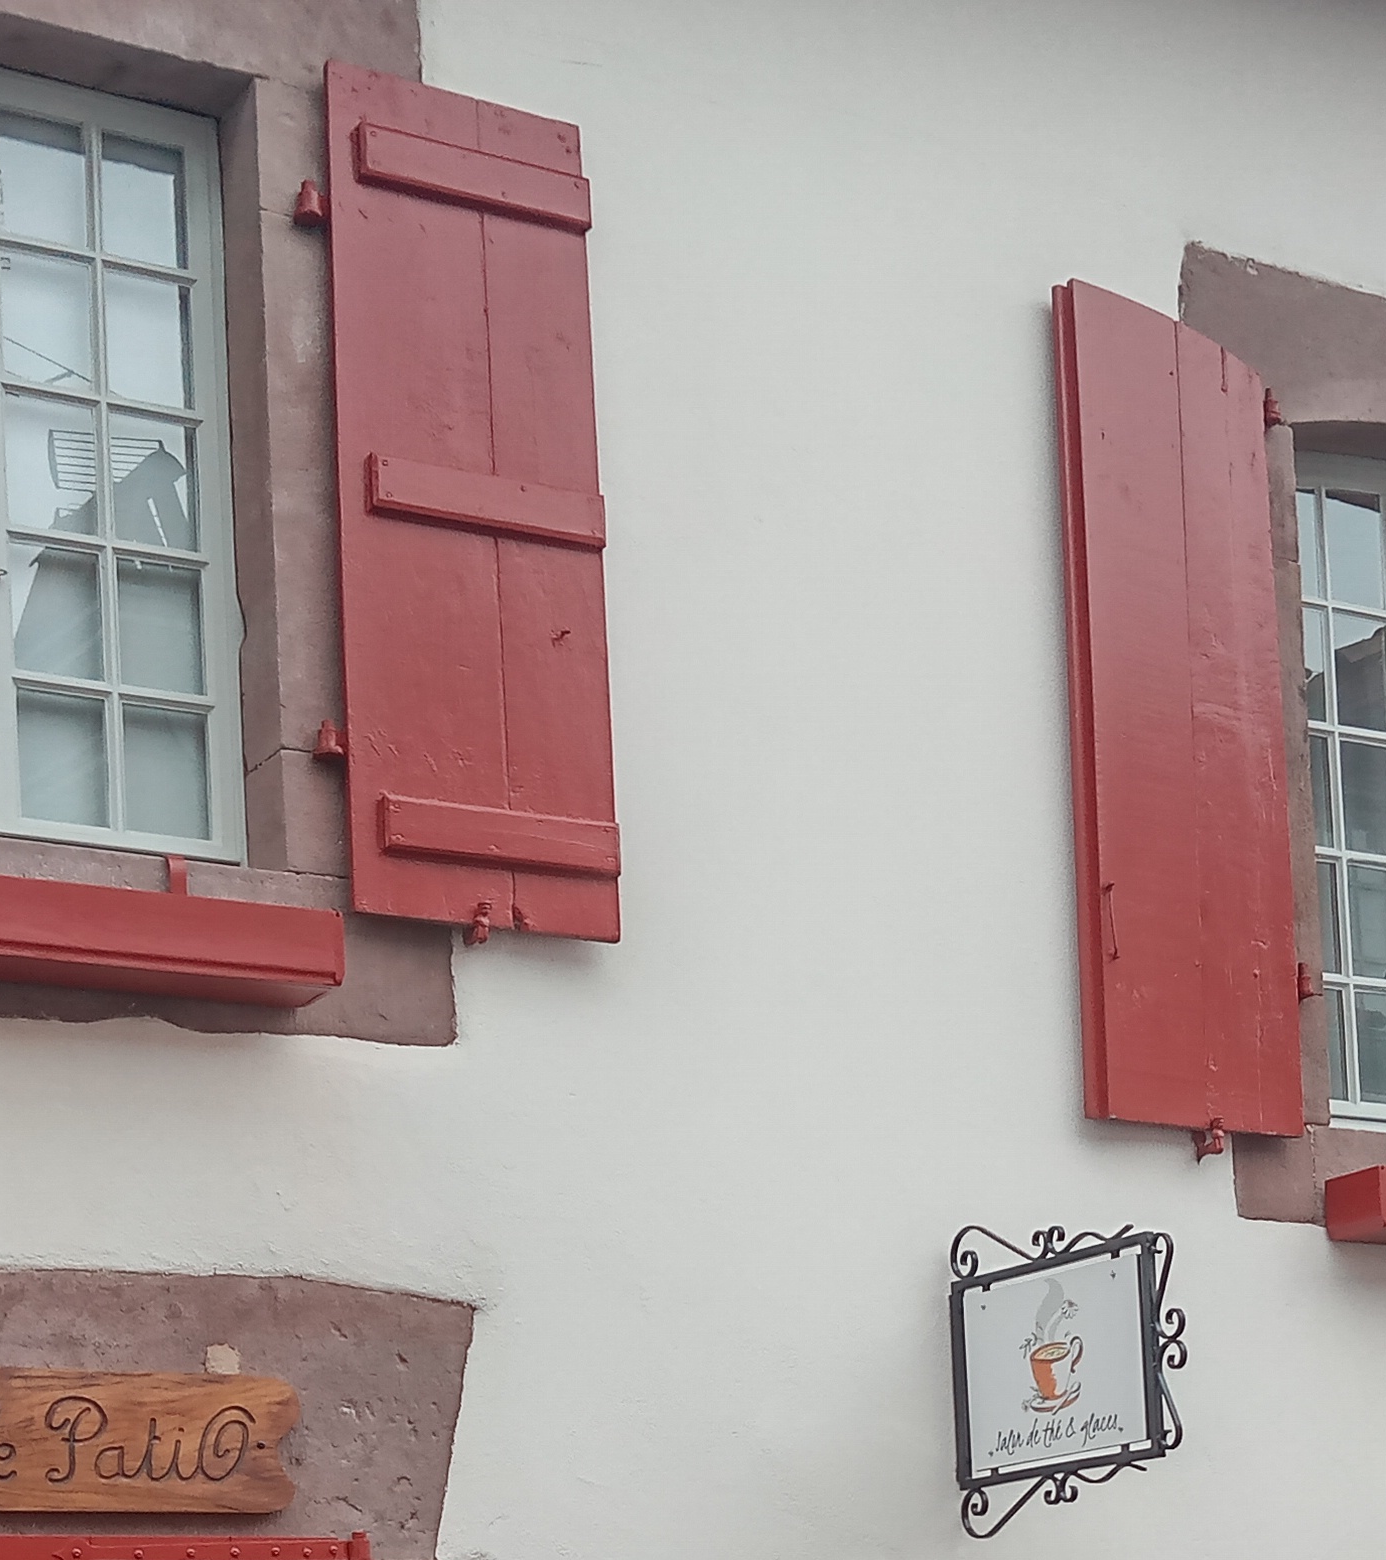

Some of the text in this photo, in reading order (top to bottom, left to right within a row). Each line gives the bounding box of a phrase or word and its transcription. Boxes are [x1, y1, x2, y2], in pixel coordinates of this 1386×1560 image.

[1026, 1418, 1041, 1448] de
[1042, 1418, 1063, 1448] thé
[1065, 1416, 1076, 1438] &
